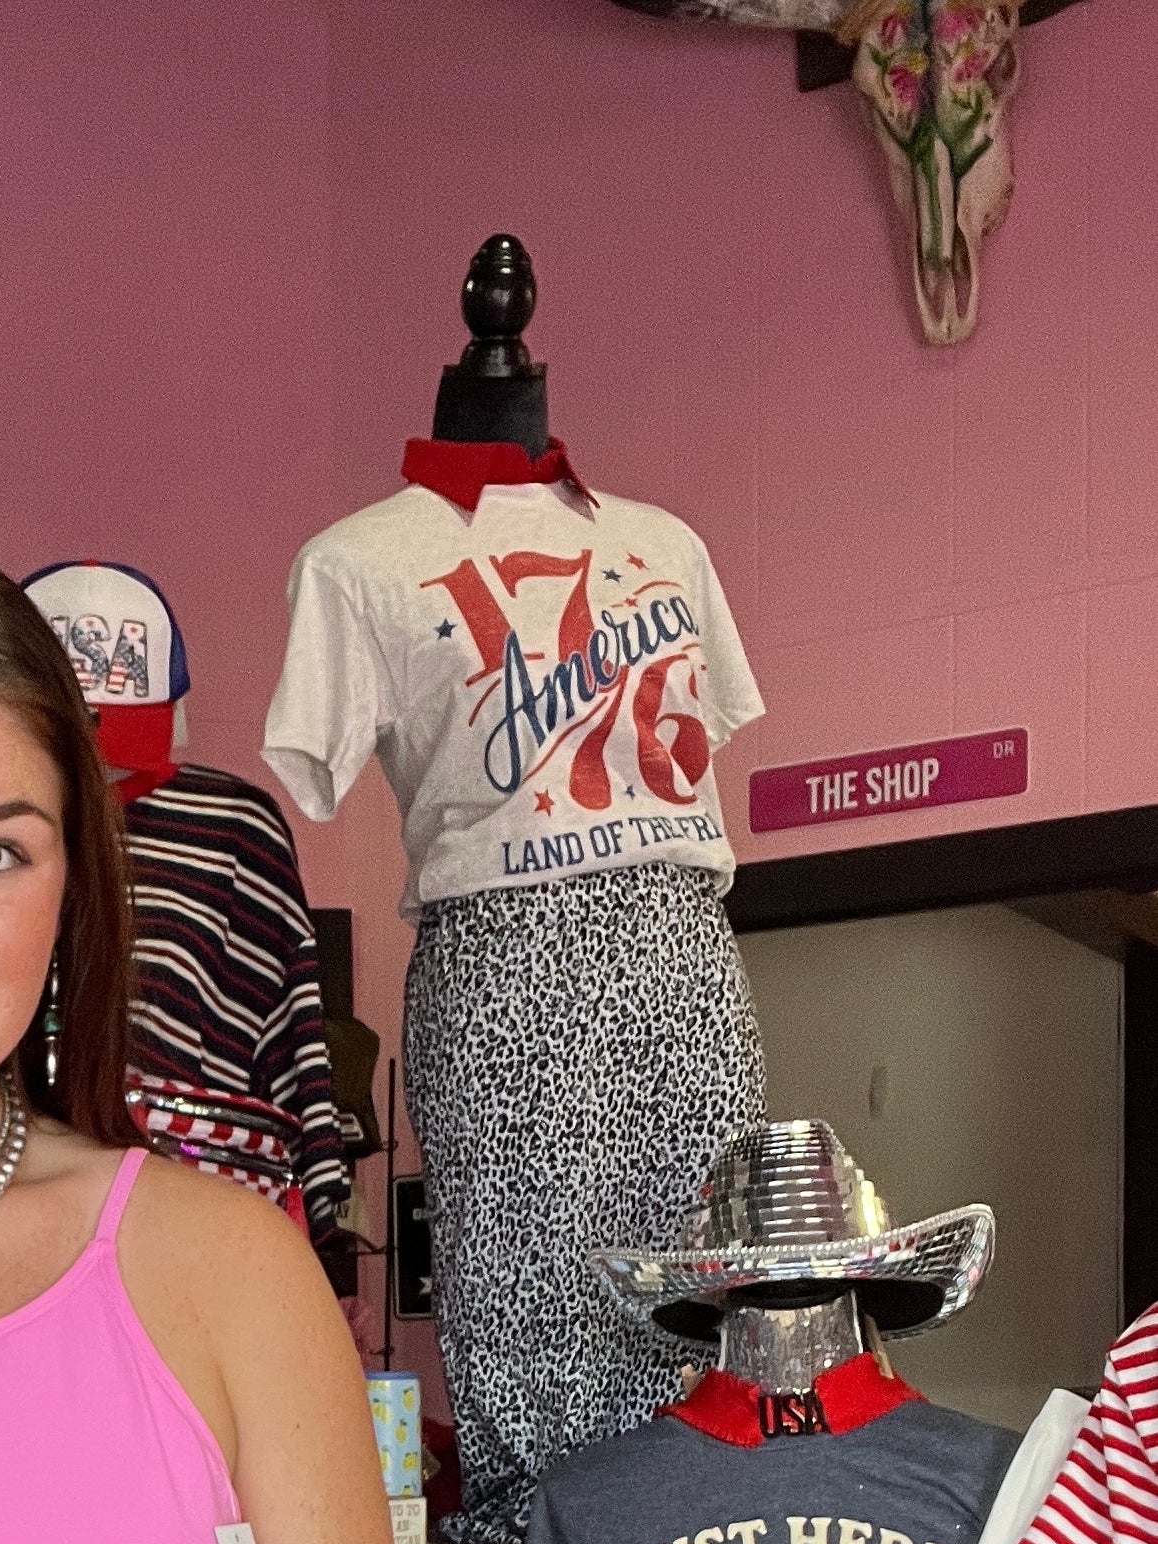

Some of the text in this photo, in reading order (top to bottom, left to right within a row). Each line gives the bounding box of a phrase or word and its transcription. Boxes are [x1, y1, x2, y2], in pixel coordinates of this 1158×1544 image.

[419, 549, 594, 690] 17
[484, 596, 699, 793] America
[569, 653, 710, 811] 76
[992, 740, 1015, 759] DR
[805, 758, 939, 813] THE SHOP
[502, 832, 585, 876] LAND
[591, 820, 625, 858] OF
[629, 816, 681, 847] THE
[759, 1391, 832, 1438] USA
